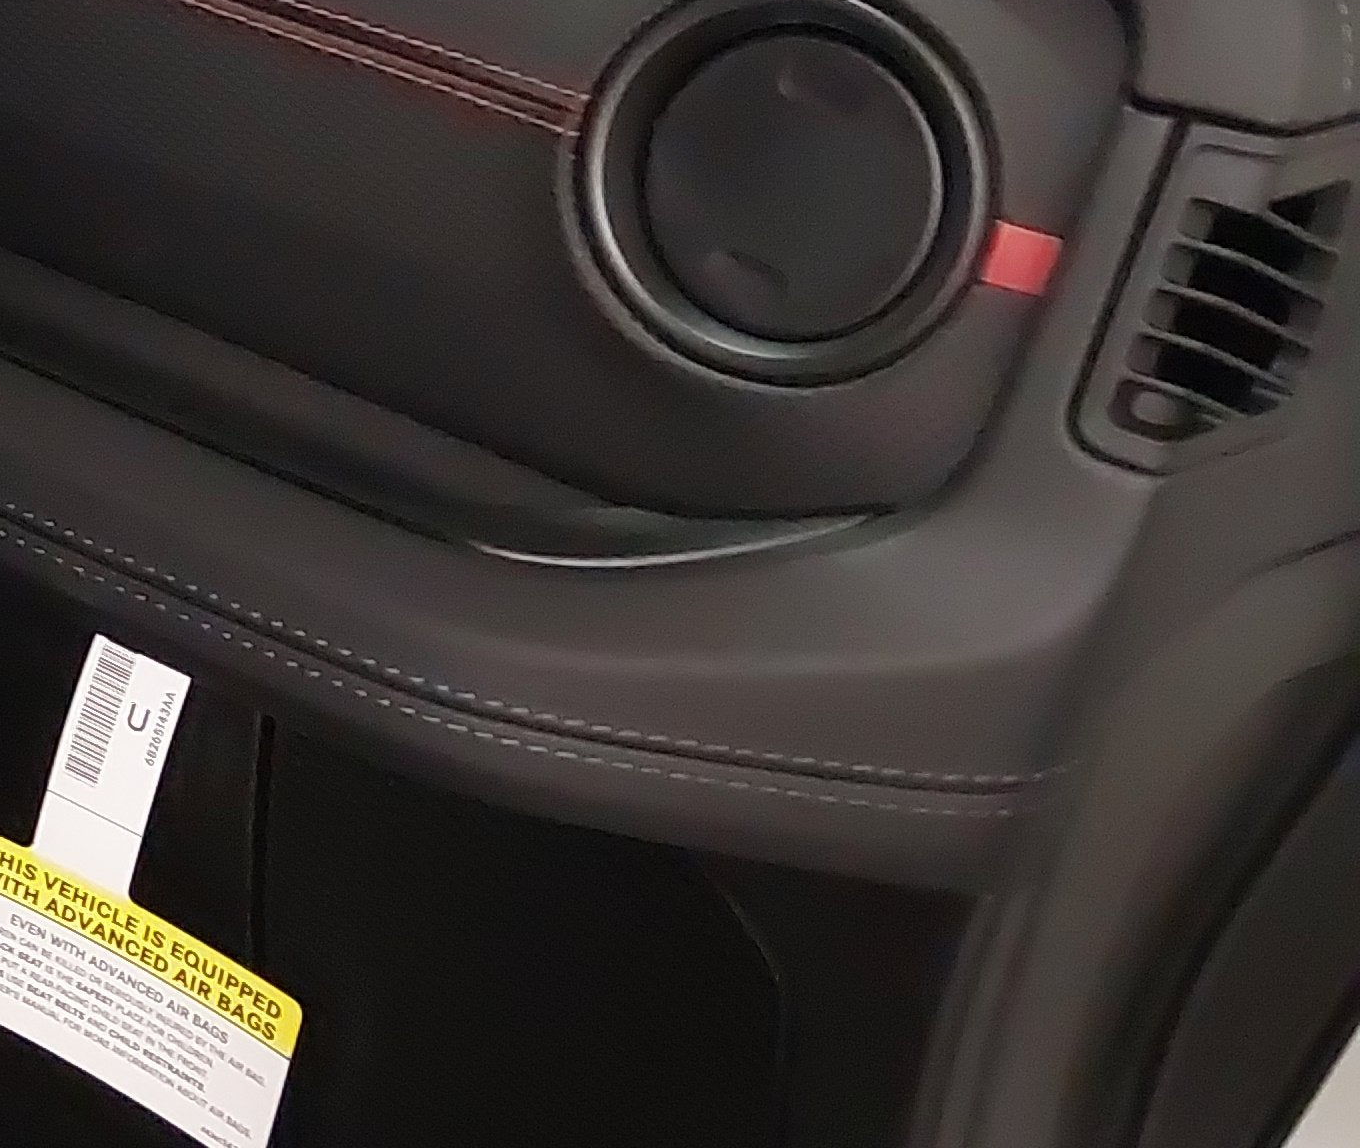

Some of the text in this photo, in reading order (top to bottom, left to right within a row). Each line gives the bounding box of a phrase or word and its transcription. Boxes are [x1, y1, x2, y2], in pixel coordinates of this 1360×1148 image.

[127, 702, 151, 733] U
[10, 913, 229, 1044] EVEN WITH ADVANCED AIR BAGS
[43, 899, 170, 975] ADVANCED
[172, 969, 214, 1001] AIR
[216, 991, 277, 1042] BAGS
[49, 874, 139, 936] VEHICLE
[141, 925, 167, 950] IS
[169, 941, 283, 1020] EQUIPPED
